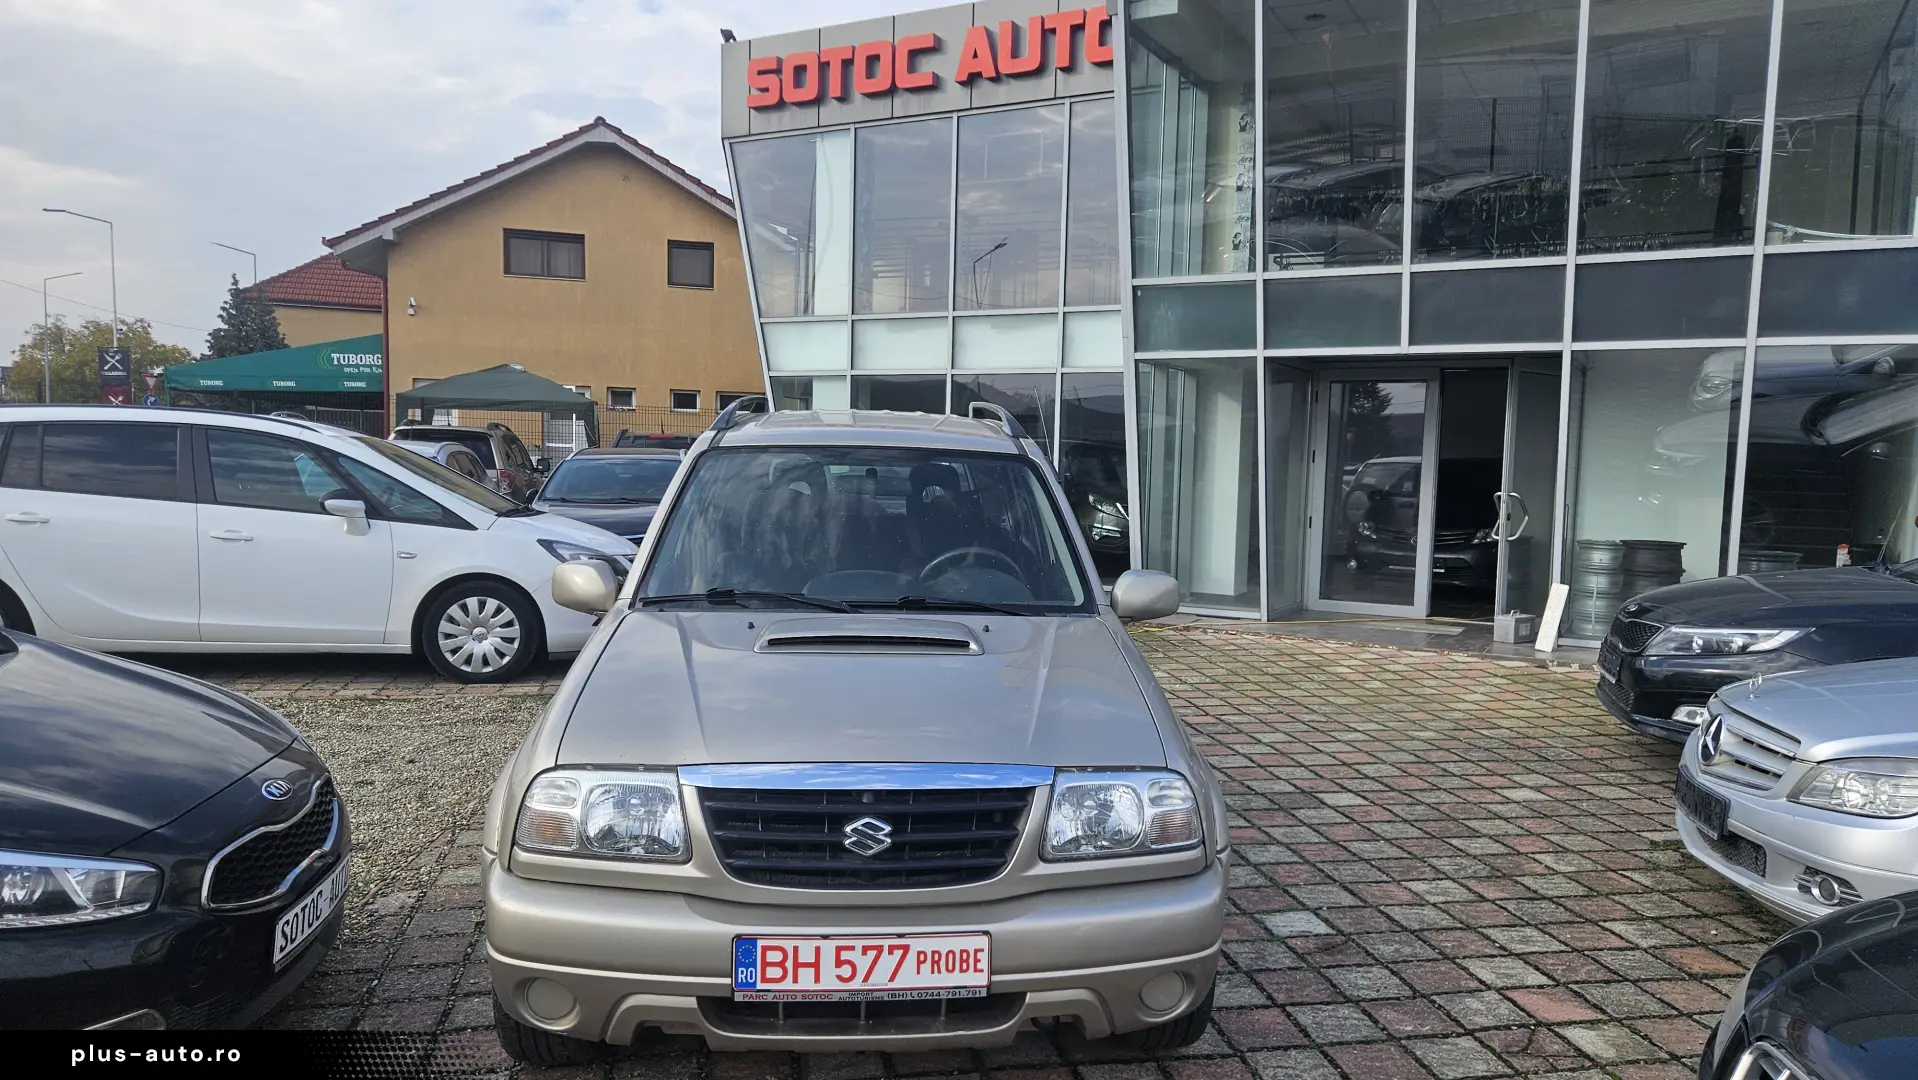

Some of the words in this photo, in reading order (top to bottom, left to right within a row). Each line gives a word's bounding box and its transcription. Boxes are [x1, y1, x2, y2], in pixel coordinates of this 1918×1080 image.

[747, 33, 937, 109] SOTOC
[331, 353, 382, 365] TUBORG
[266, 780, 292, 798] KIA
[760, 945, 821, 984] BH
[834, 944, 911, 984] 577
[916, 947, 985, 975] PROBE
[738, 967, 756, 983] RO
[742, 993, 768, 1001] PARC
[772, 993, 798, 1001] AUTO
[801, 993, 834, 1001] SOTOC
[887, 992, 908, 1000] (BH)
[916, 989, 982, 999] 0744-791.791
